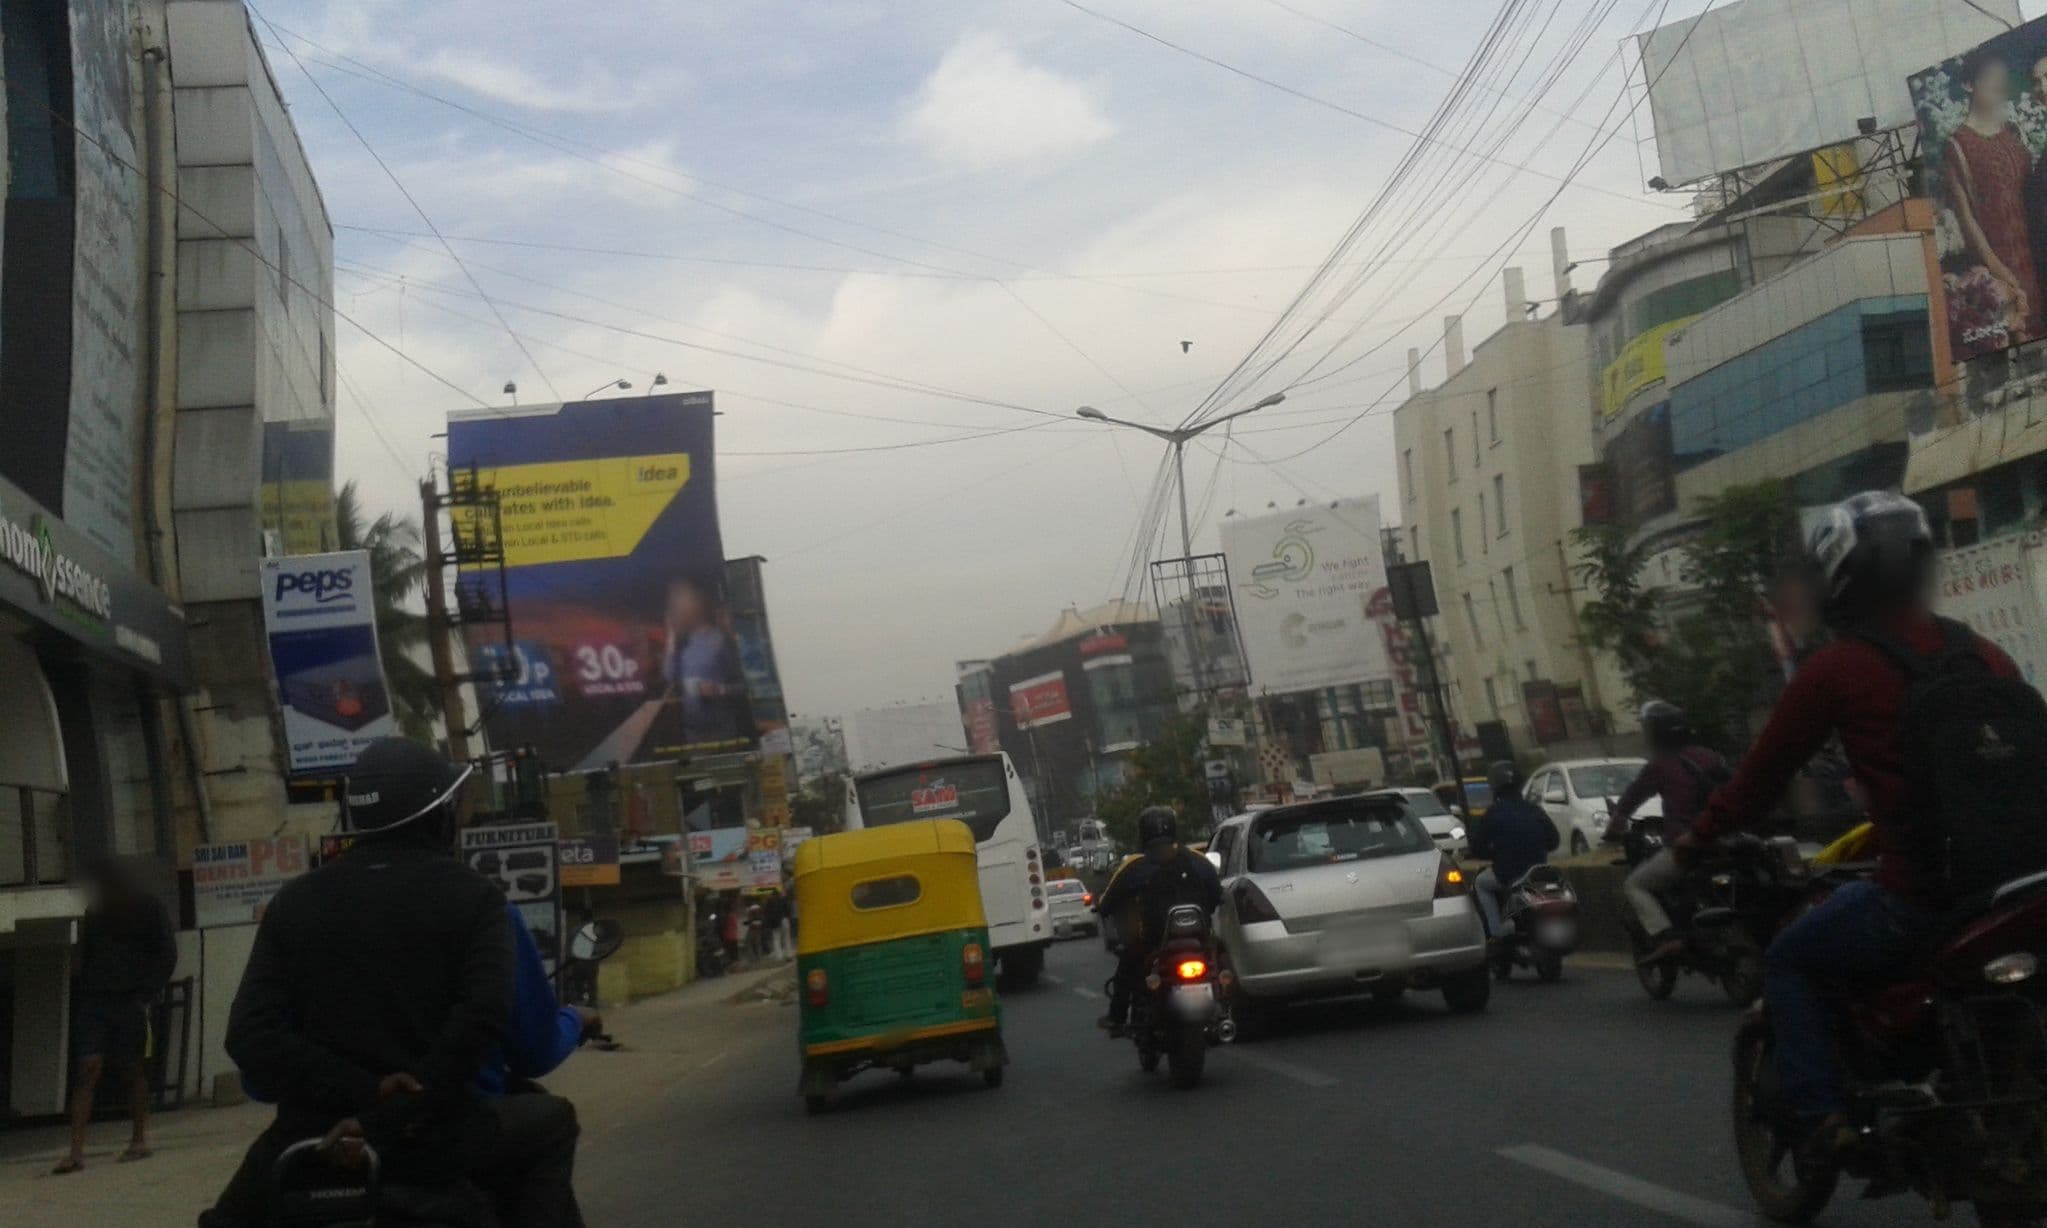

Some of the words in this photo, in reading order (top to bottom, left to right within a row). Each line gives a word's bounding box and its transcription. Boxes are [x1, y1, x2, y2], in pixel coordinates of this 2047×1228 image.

[501, 501, 536, 516] ates
[542, 496, 575, 511] with
[275, 568, 353, 603] peps
